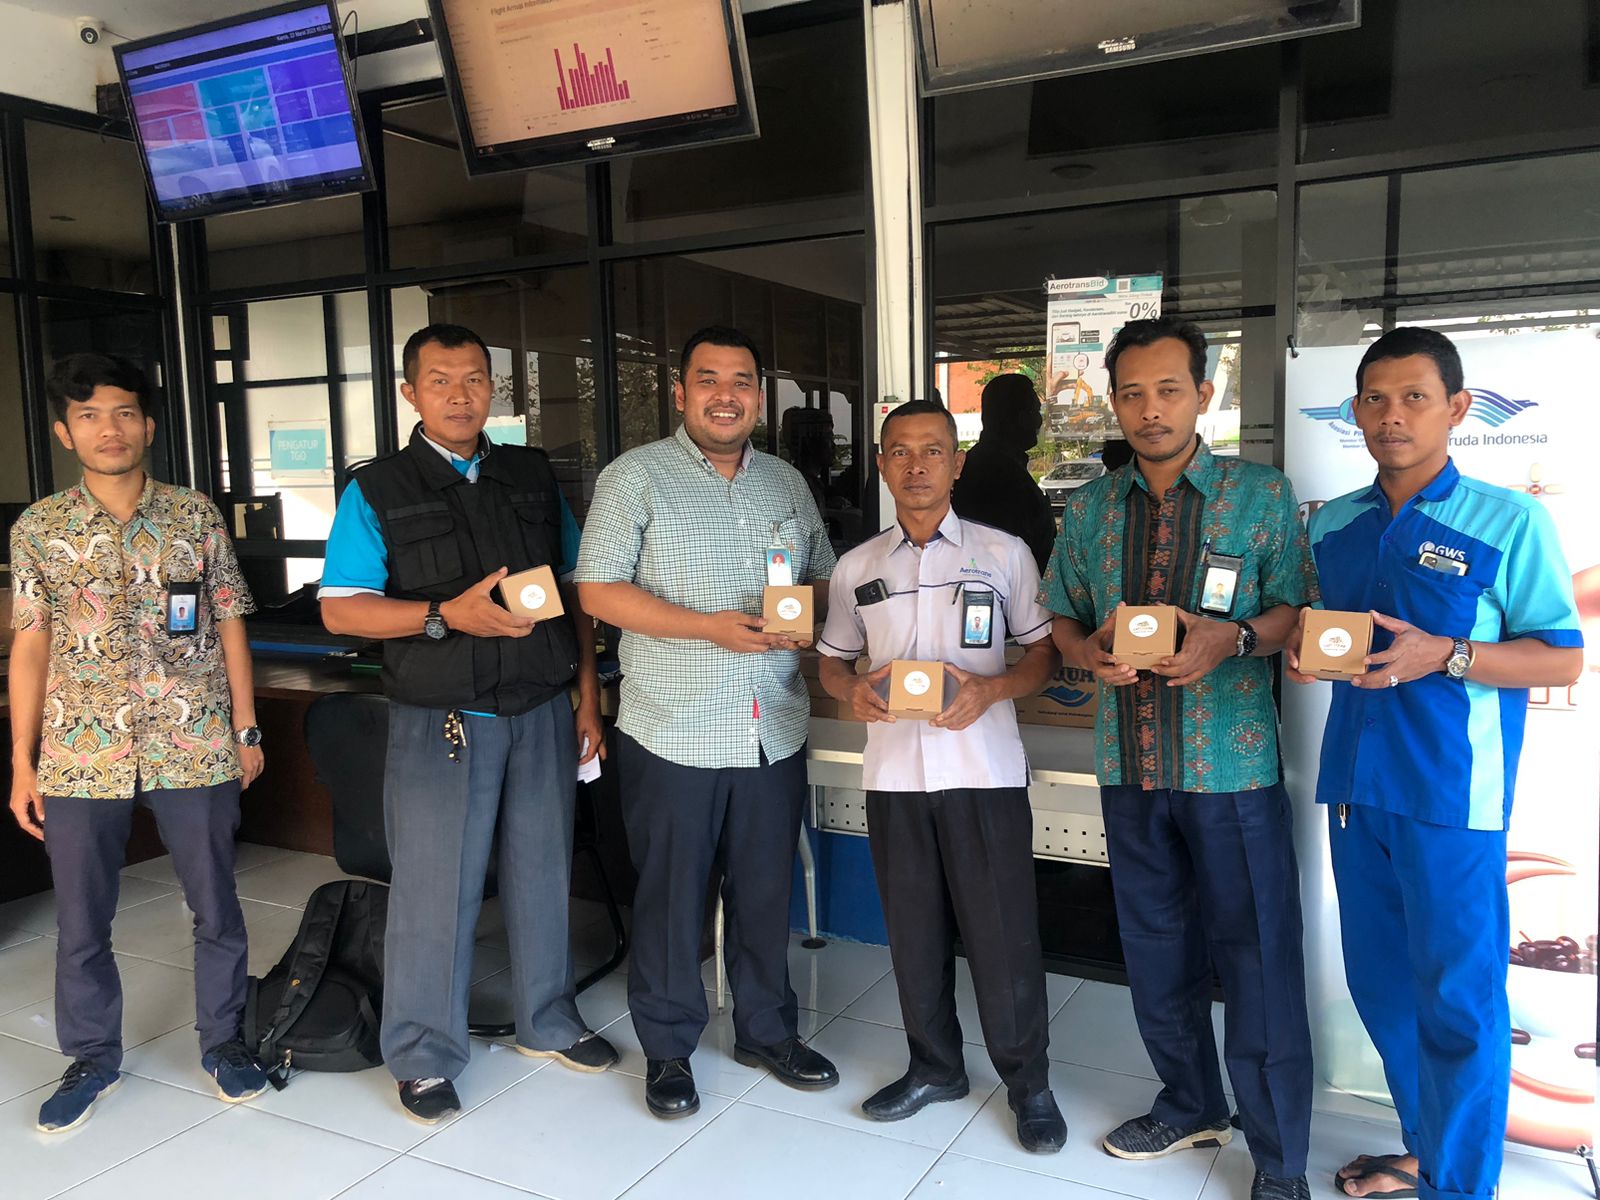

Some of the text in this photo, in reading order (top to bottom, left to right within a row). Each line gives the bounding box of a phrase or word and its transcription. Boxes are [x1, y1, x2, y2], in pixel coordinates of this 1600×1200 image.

[1105, 43, 1136, 54] SAMSUNG
[1049, 280, 1105, 291] AerotransBid
[1130, 301, 1158, 319] 0%
[277, 439, 319, 450] PENGATUR
[1448, 433, 1548, 447] ruda Indonesia
[1435, 545, 1466, 561] GWS
[959, 567, 992, 578] Aerotrans
